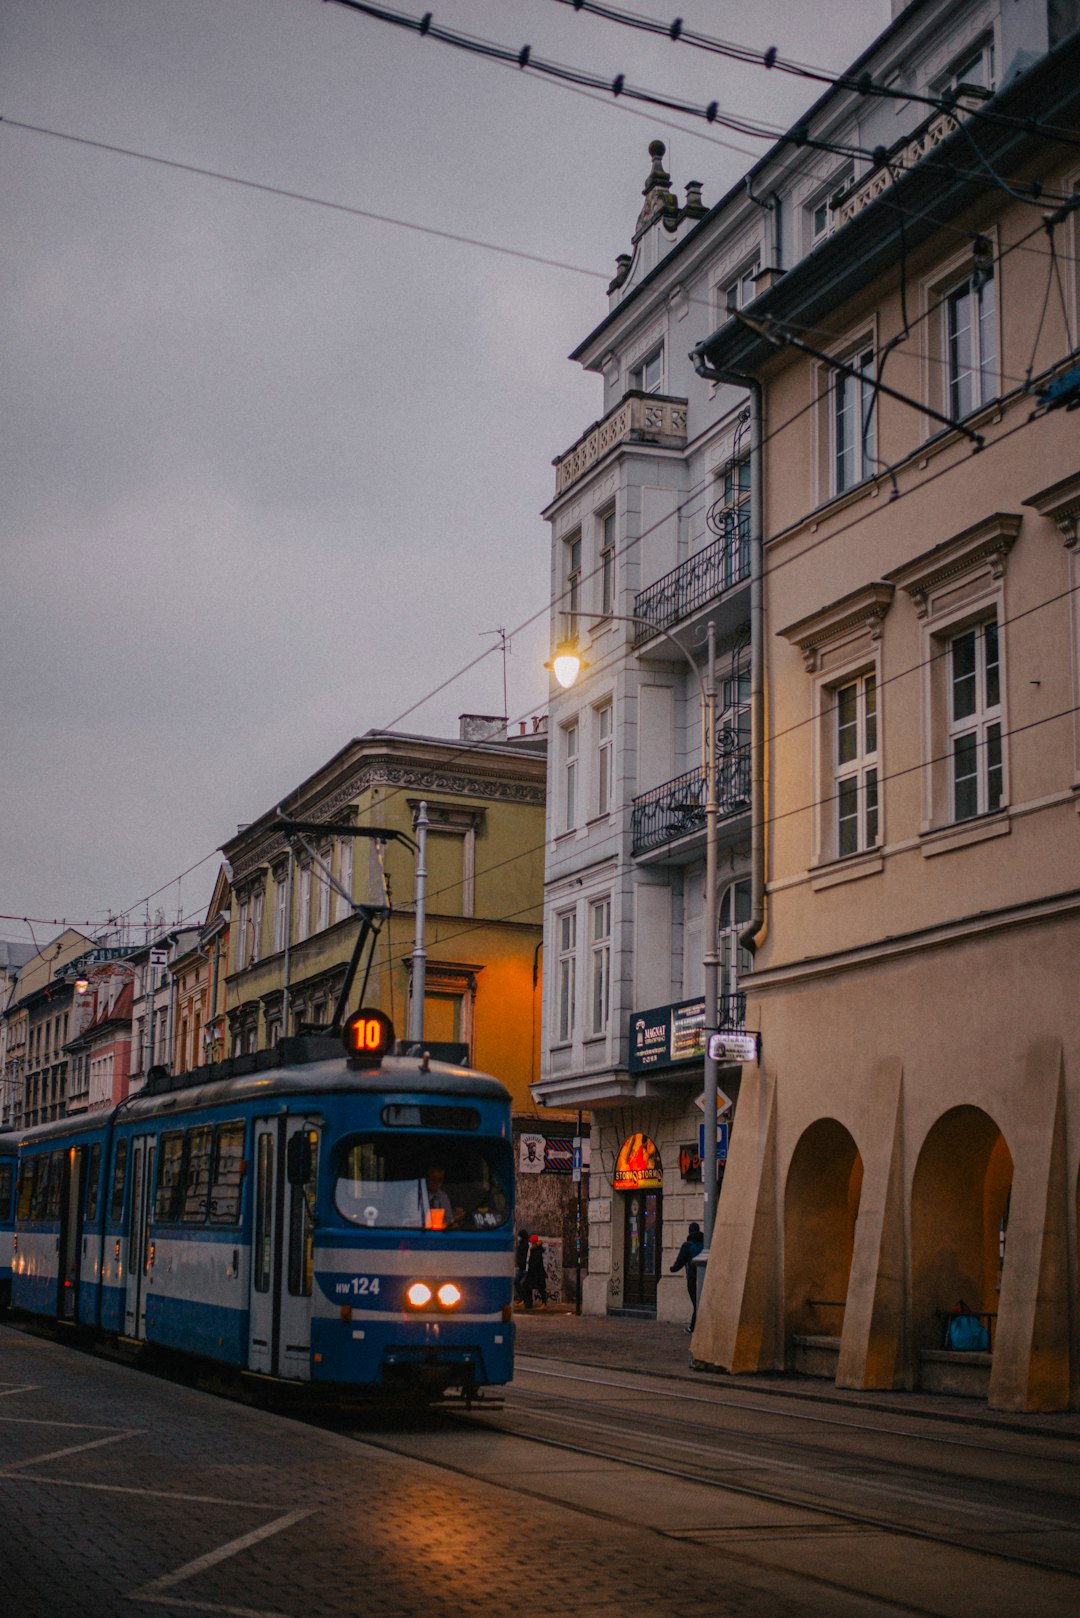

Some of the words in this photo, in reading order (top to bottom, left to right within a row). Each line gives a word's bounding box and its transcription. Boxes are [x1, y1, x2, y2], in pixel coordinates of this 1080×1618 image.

[352, 1019, 381, 1049] 10
[335, 1283, 350, 1295] HW
[351, 1277, 380, 1296] 124
